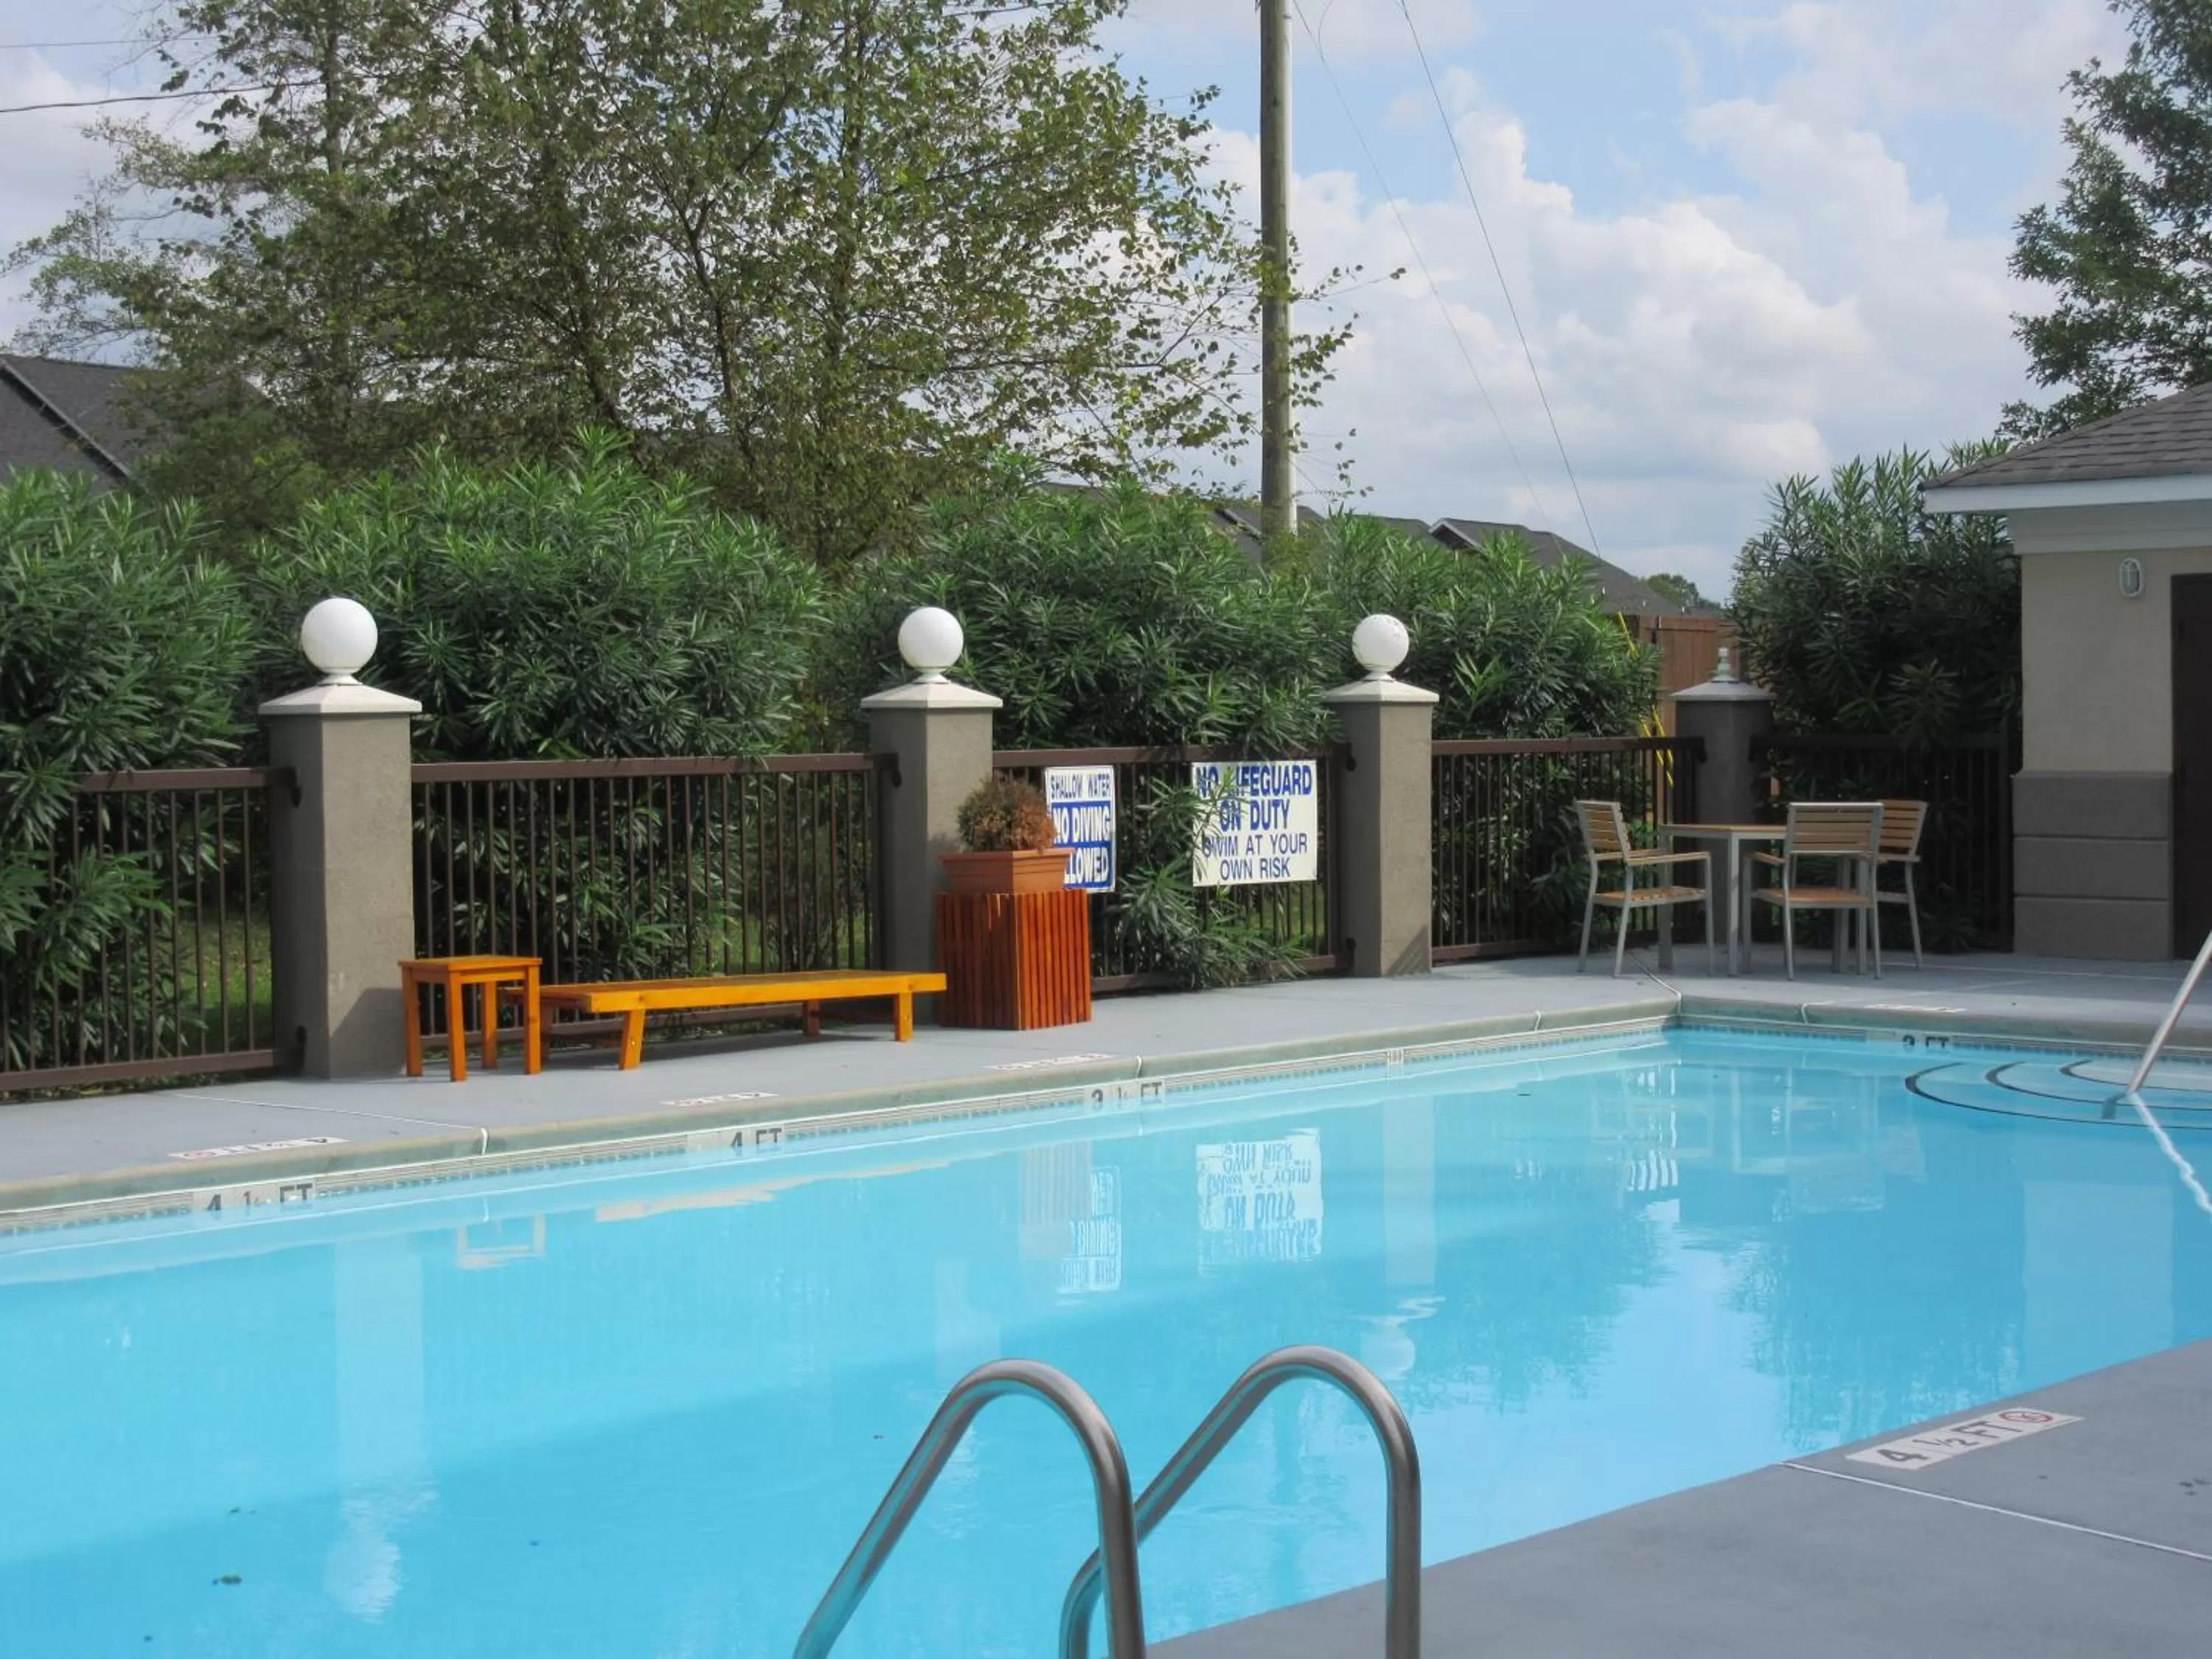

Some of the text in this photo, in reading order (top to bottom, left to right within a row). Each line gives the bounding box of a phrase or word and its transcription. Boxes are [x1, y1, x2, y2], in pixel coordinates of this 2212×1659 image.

[1088, 773, 1110, 798] WATER
[1224, 765, 1312, 797] IFEGUARD
[1053, 806, 1110, 844] NO DIVING
[1220, 798, 1290, 832] ON DUTY
[1245, 835, 1263, 856] AT
[1270, 832, 1308, 854] YOUR
[1220, 858, 1290, 881] OWN RISK
[1877, 1448, 1930, 1463] 4
[1950, 1420, 2023, 1439] FT
